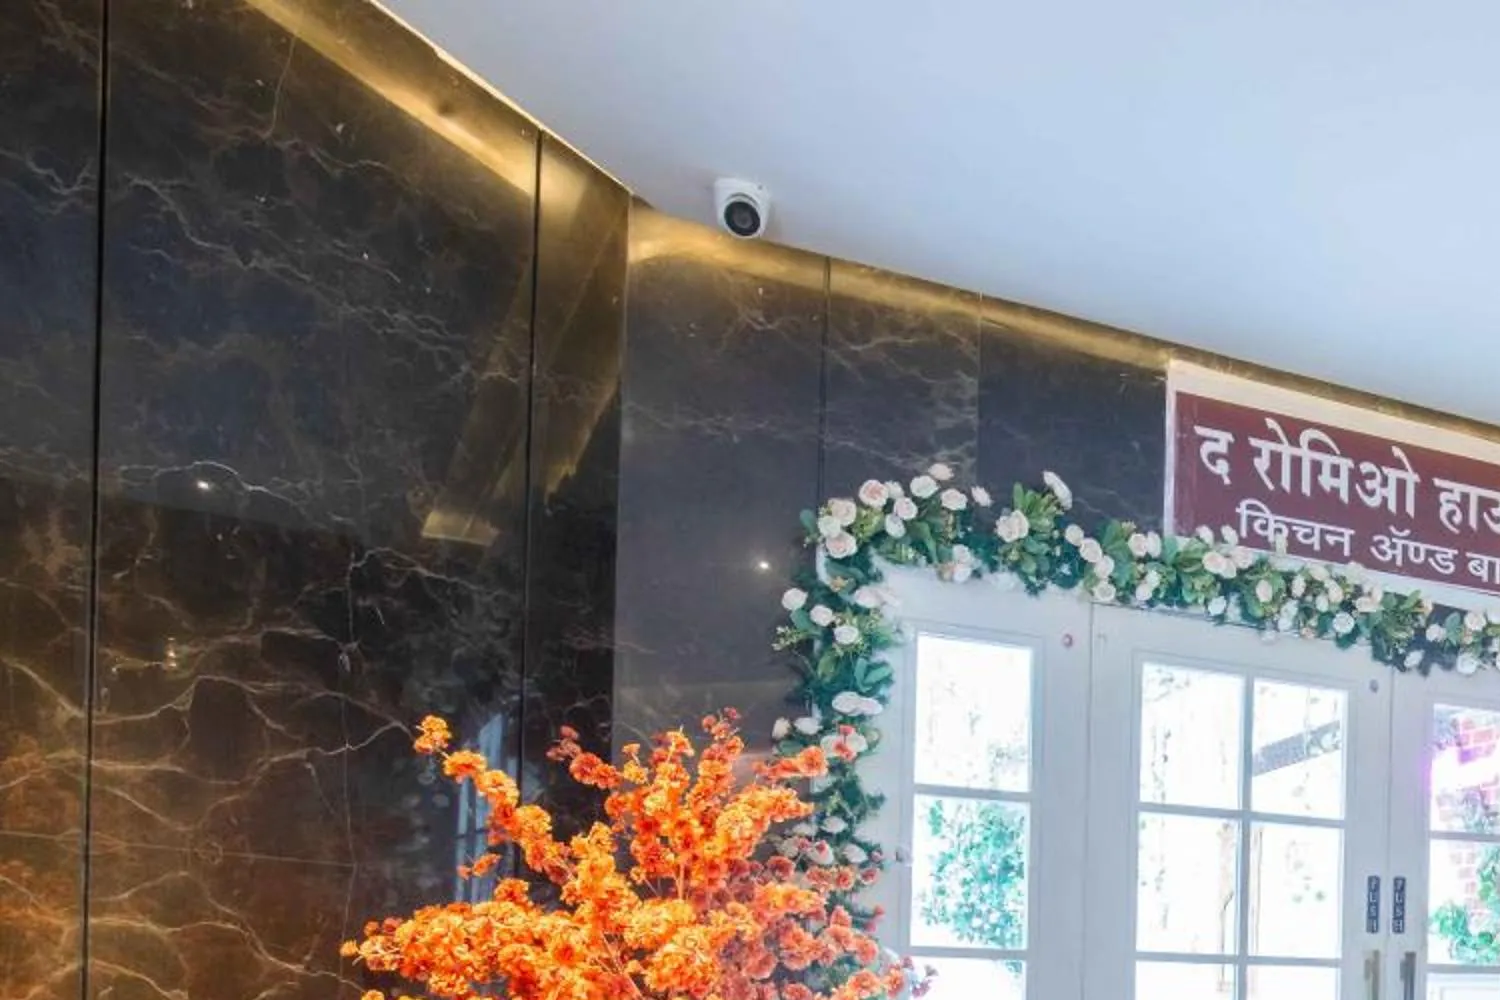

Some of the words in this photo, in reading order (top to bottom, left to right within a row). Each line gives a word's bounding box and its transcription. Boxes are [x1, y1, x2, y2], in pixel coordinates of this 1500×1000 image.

[1194, 424, 1235, 485] द
[1248, 418, 1420, 518] रोमिओ
[1235, 499, 1355, 557] किचन
